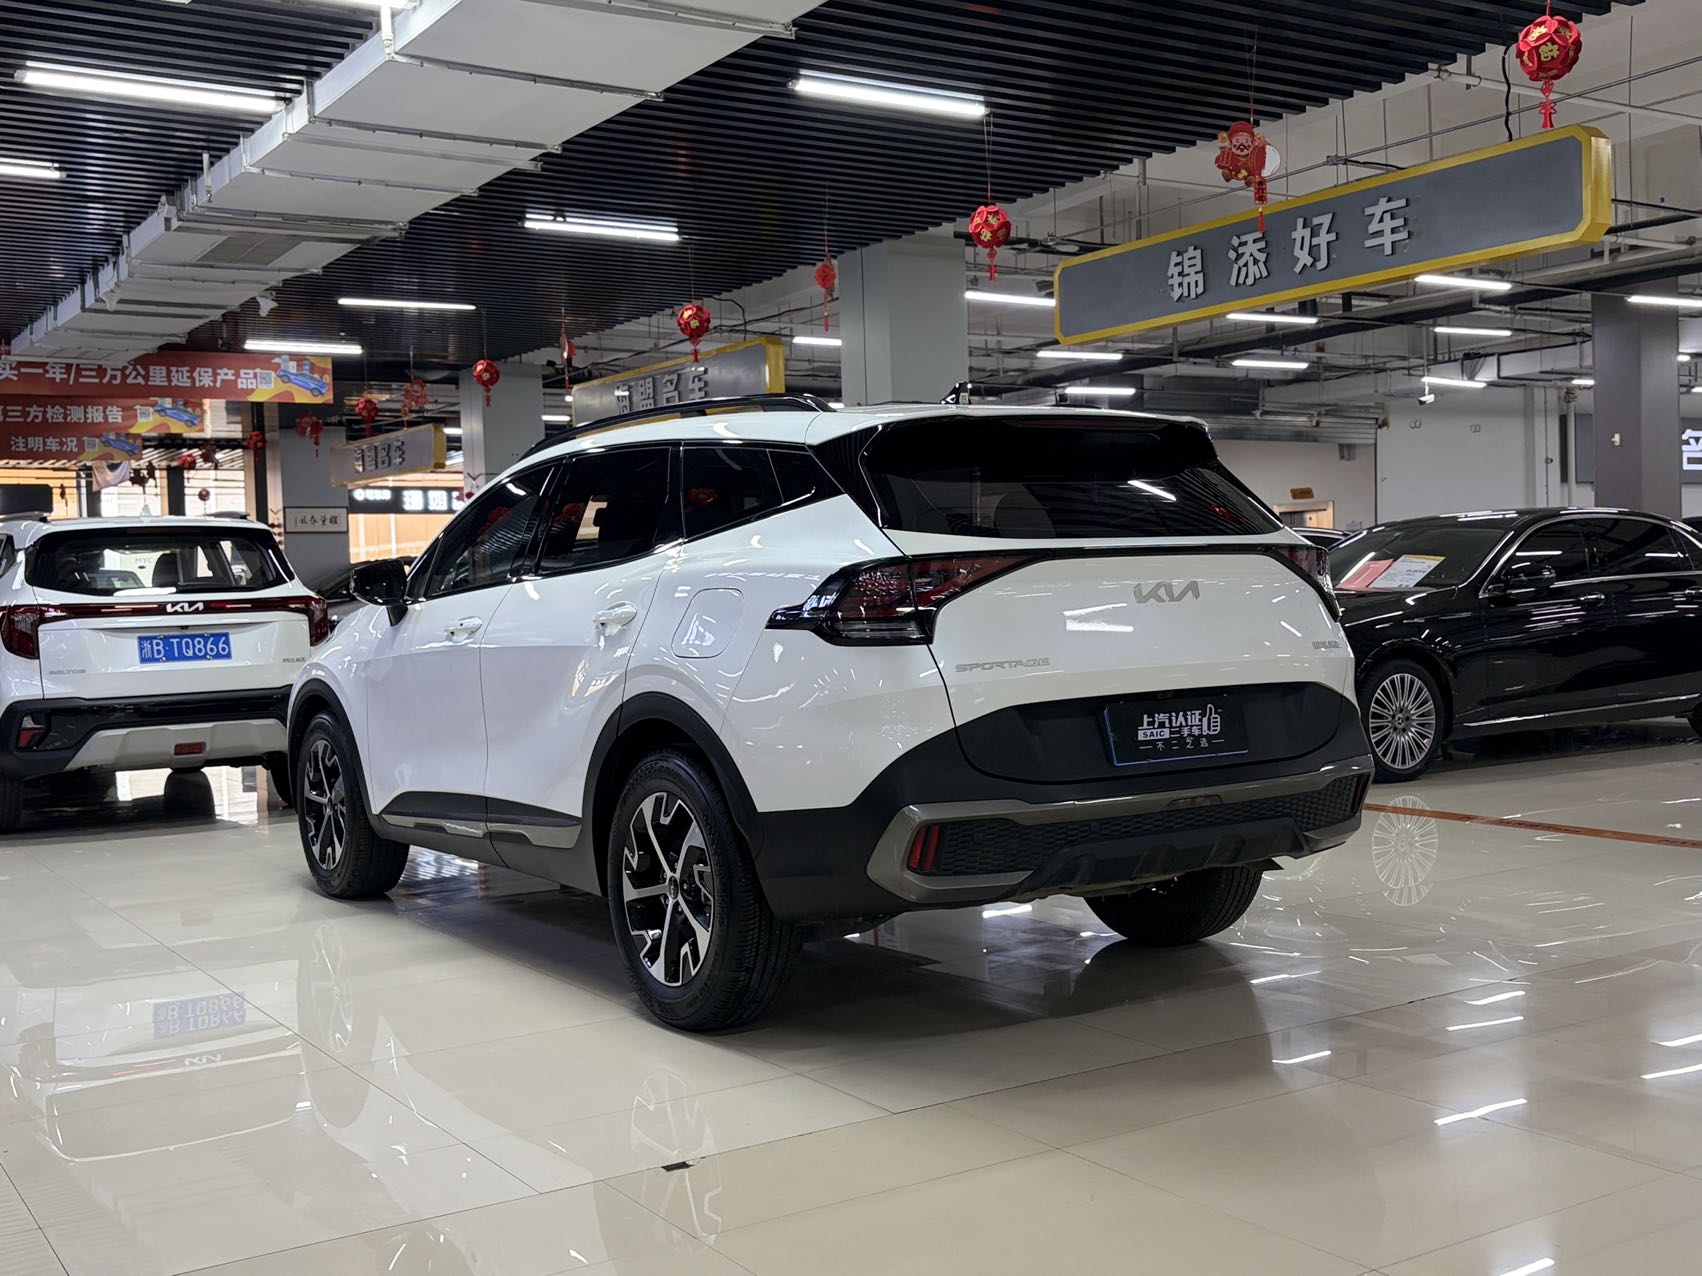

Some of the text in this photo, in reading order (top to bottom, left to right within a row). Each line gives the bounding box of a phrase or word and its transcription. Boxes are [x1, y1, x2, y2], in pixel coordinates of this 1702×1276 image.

[1165, 196, 1412, 302] 锦添好车
[0, 404, 123, 424] 三方检测报告
[11, 436, 78, 453] 注明车况
[1133, 580, 1201, 604] KIA
[165, 601, 204, 614] KIA
[955, 656, 1050, 673] SPORTAGE
[1138, 711, 1202, 729] 上汽认证
[1142, 731, 1166, 739] SAIC
[1170, 726, 1202, 737] 二手车
